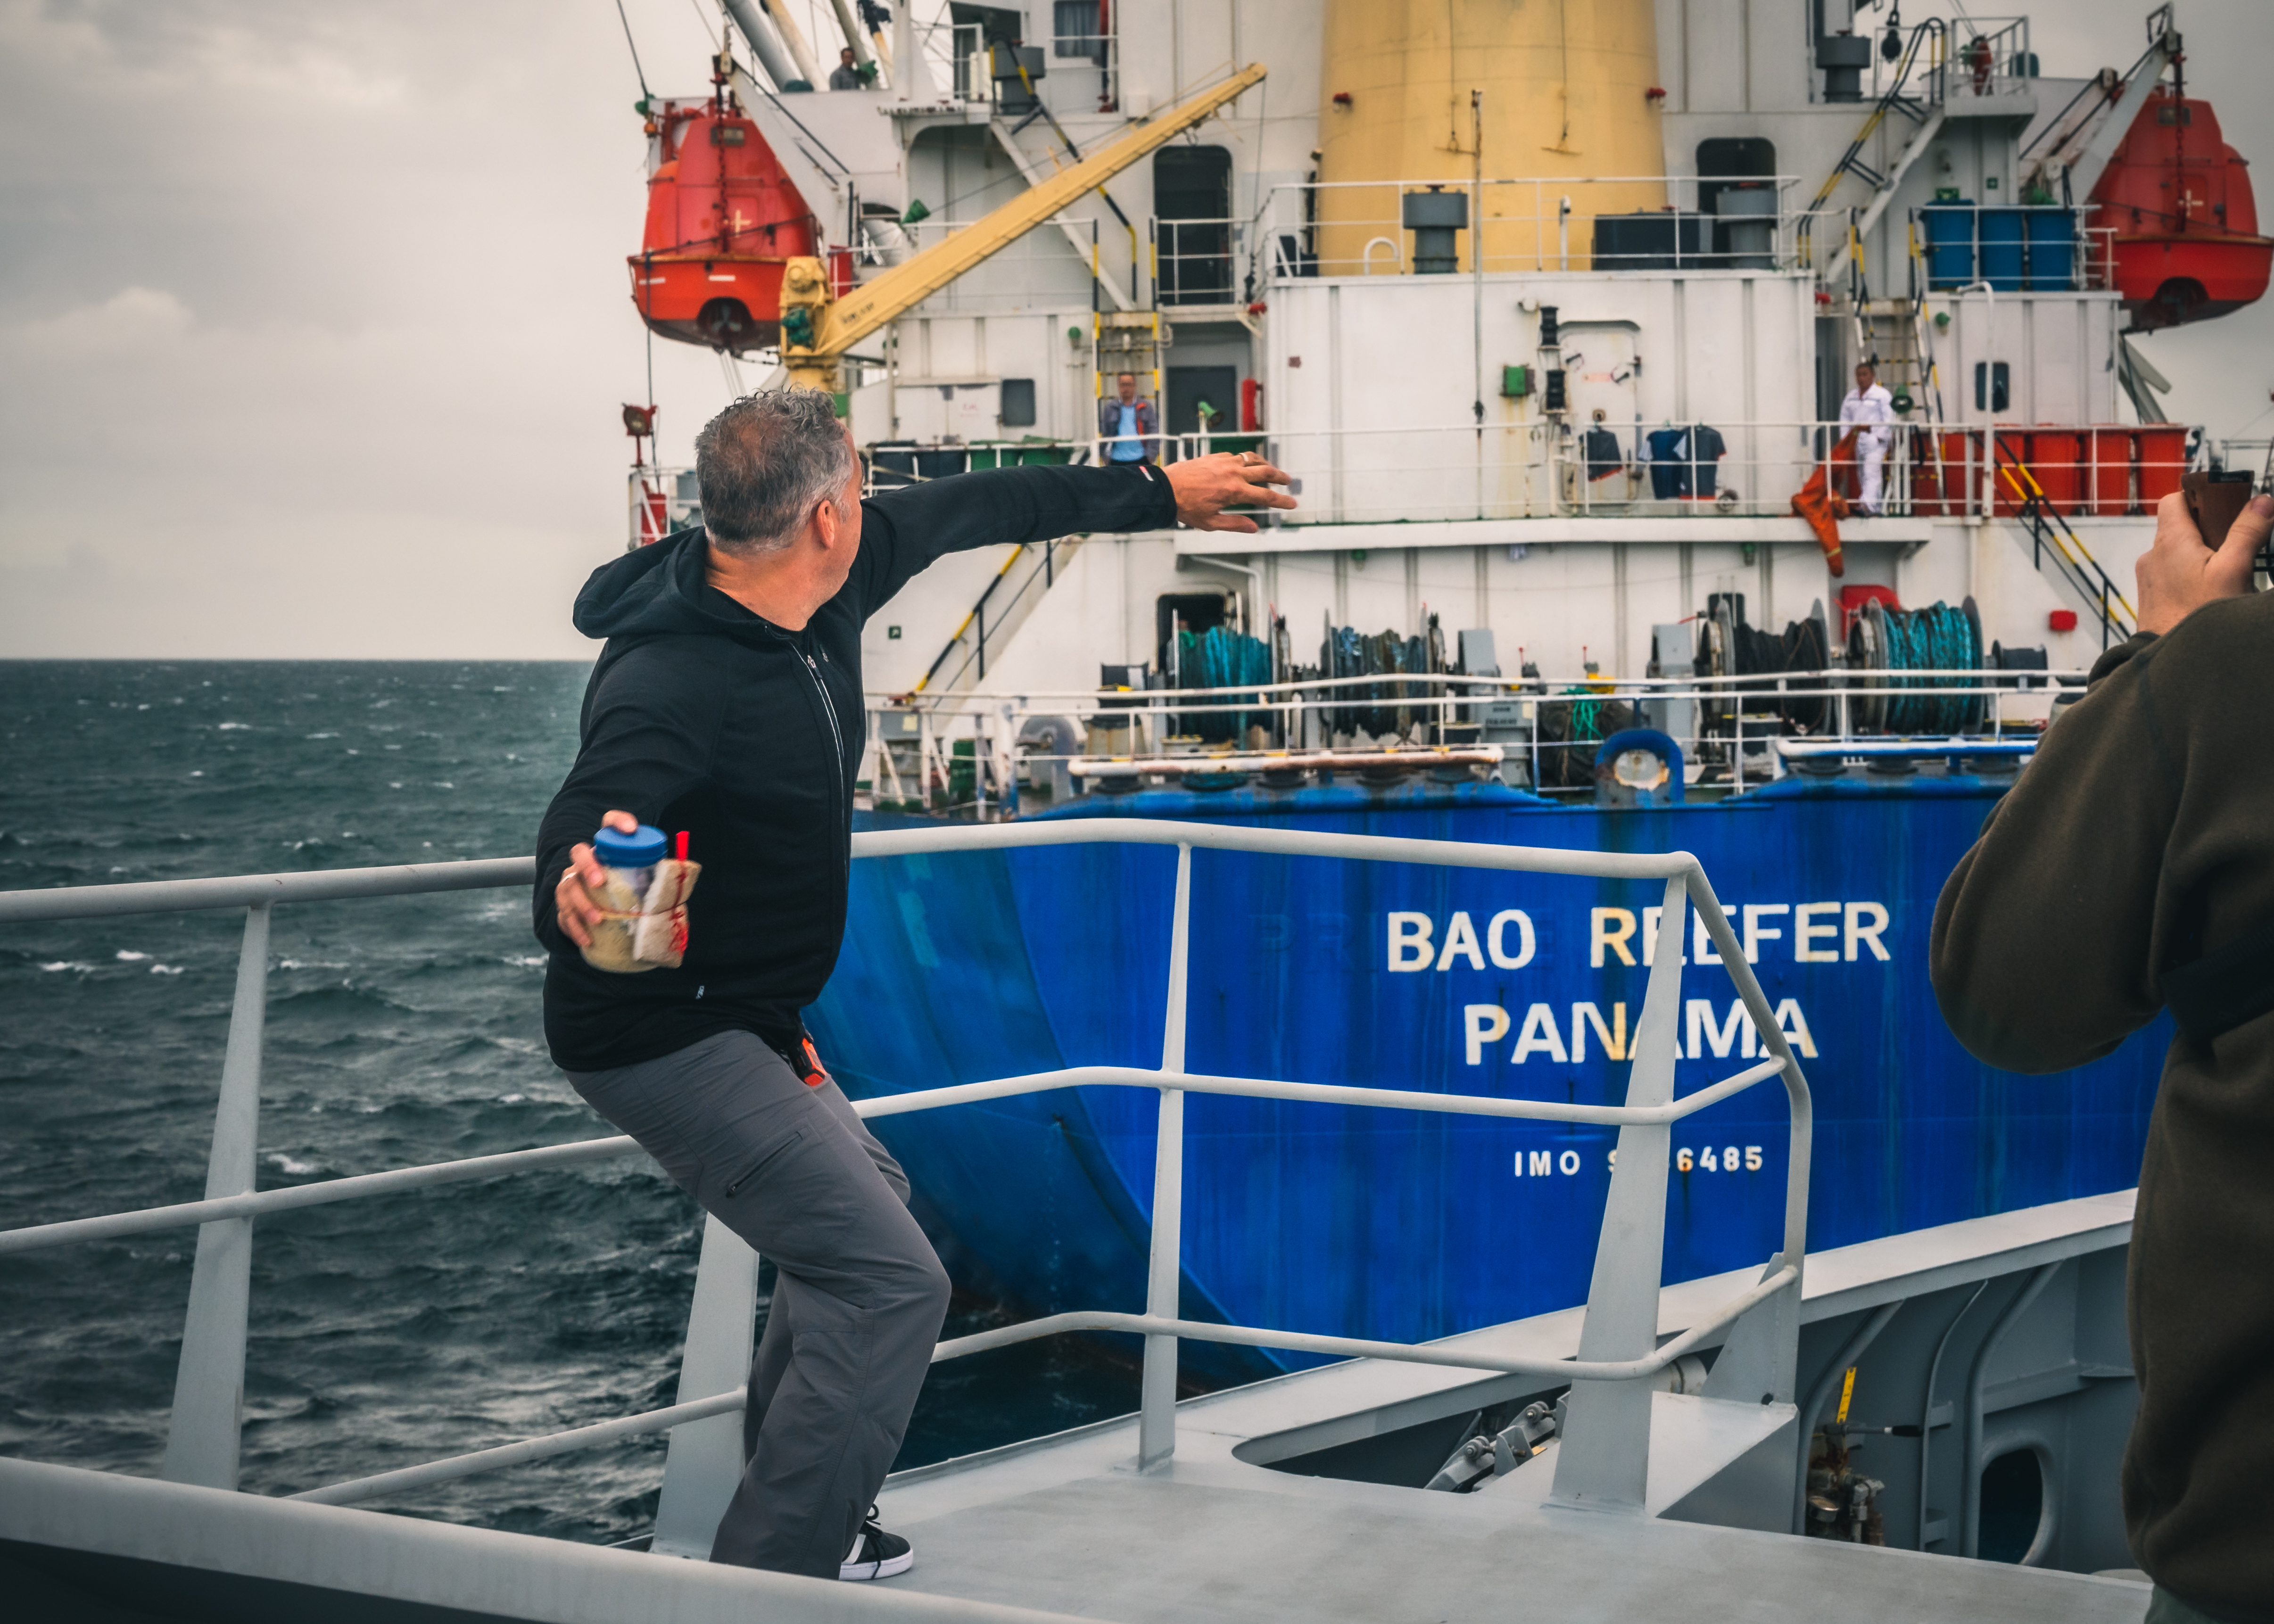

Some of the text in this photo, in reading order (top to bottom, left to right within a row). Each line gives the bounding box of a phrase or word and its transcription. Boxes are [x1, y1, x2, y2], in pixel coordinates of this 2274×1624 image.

[1387, 909, 1536, 972] BAO
[1464, 997, 1819, 1066] PANMA
[1514, 1146, 1763, 1177] IMO 6485
